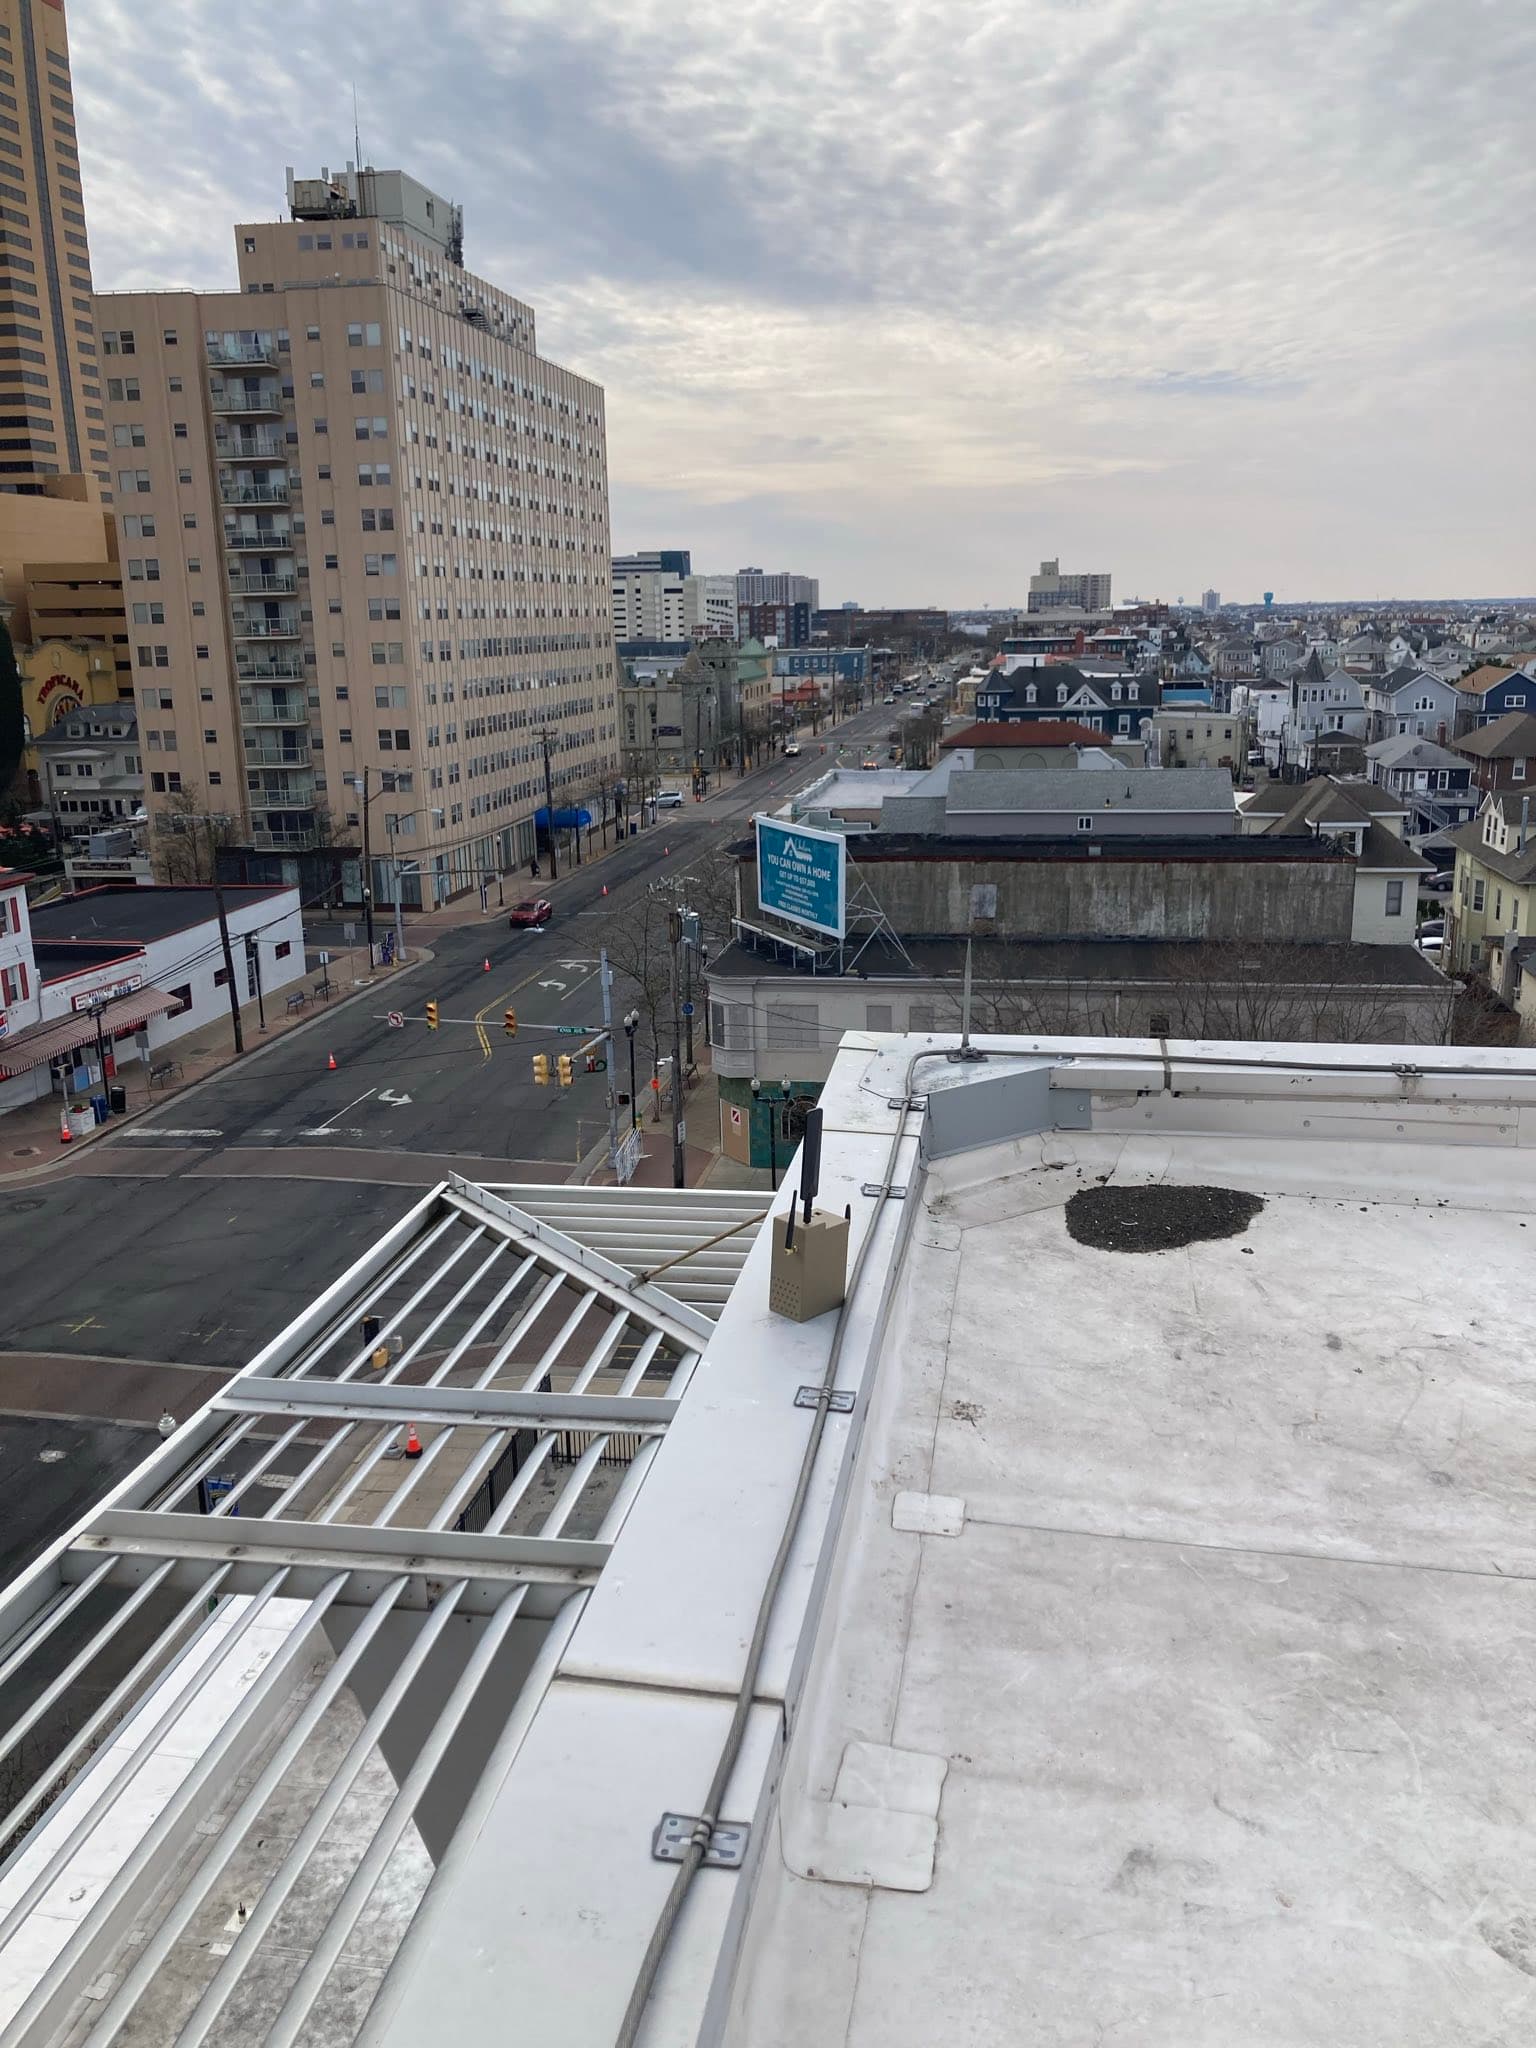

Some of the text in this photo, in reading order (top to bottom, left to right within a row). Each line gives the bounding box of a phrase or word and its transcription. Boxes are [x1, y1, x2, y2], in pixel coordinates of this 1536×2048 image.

[37, 674, 83, 704] TROPICANA
[768, 854, 779, 865] YOU
[779, 857, 791, 870] CAN
[792, 860, 806, 875] OWN
[806, 866, 812, 877] A
[812, 868, 831, 881] HOME
